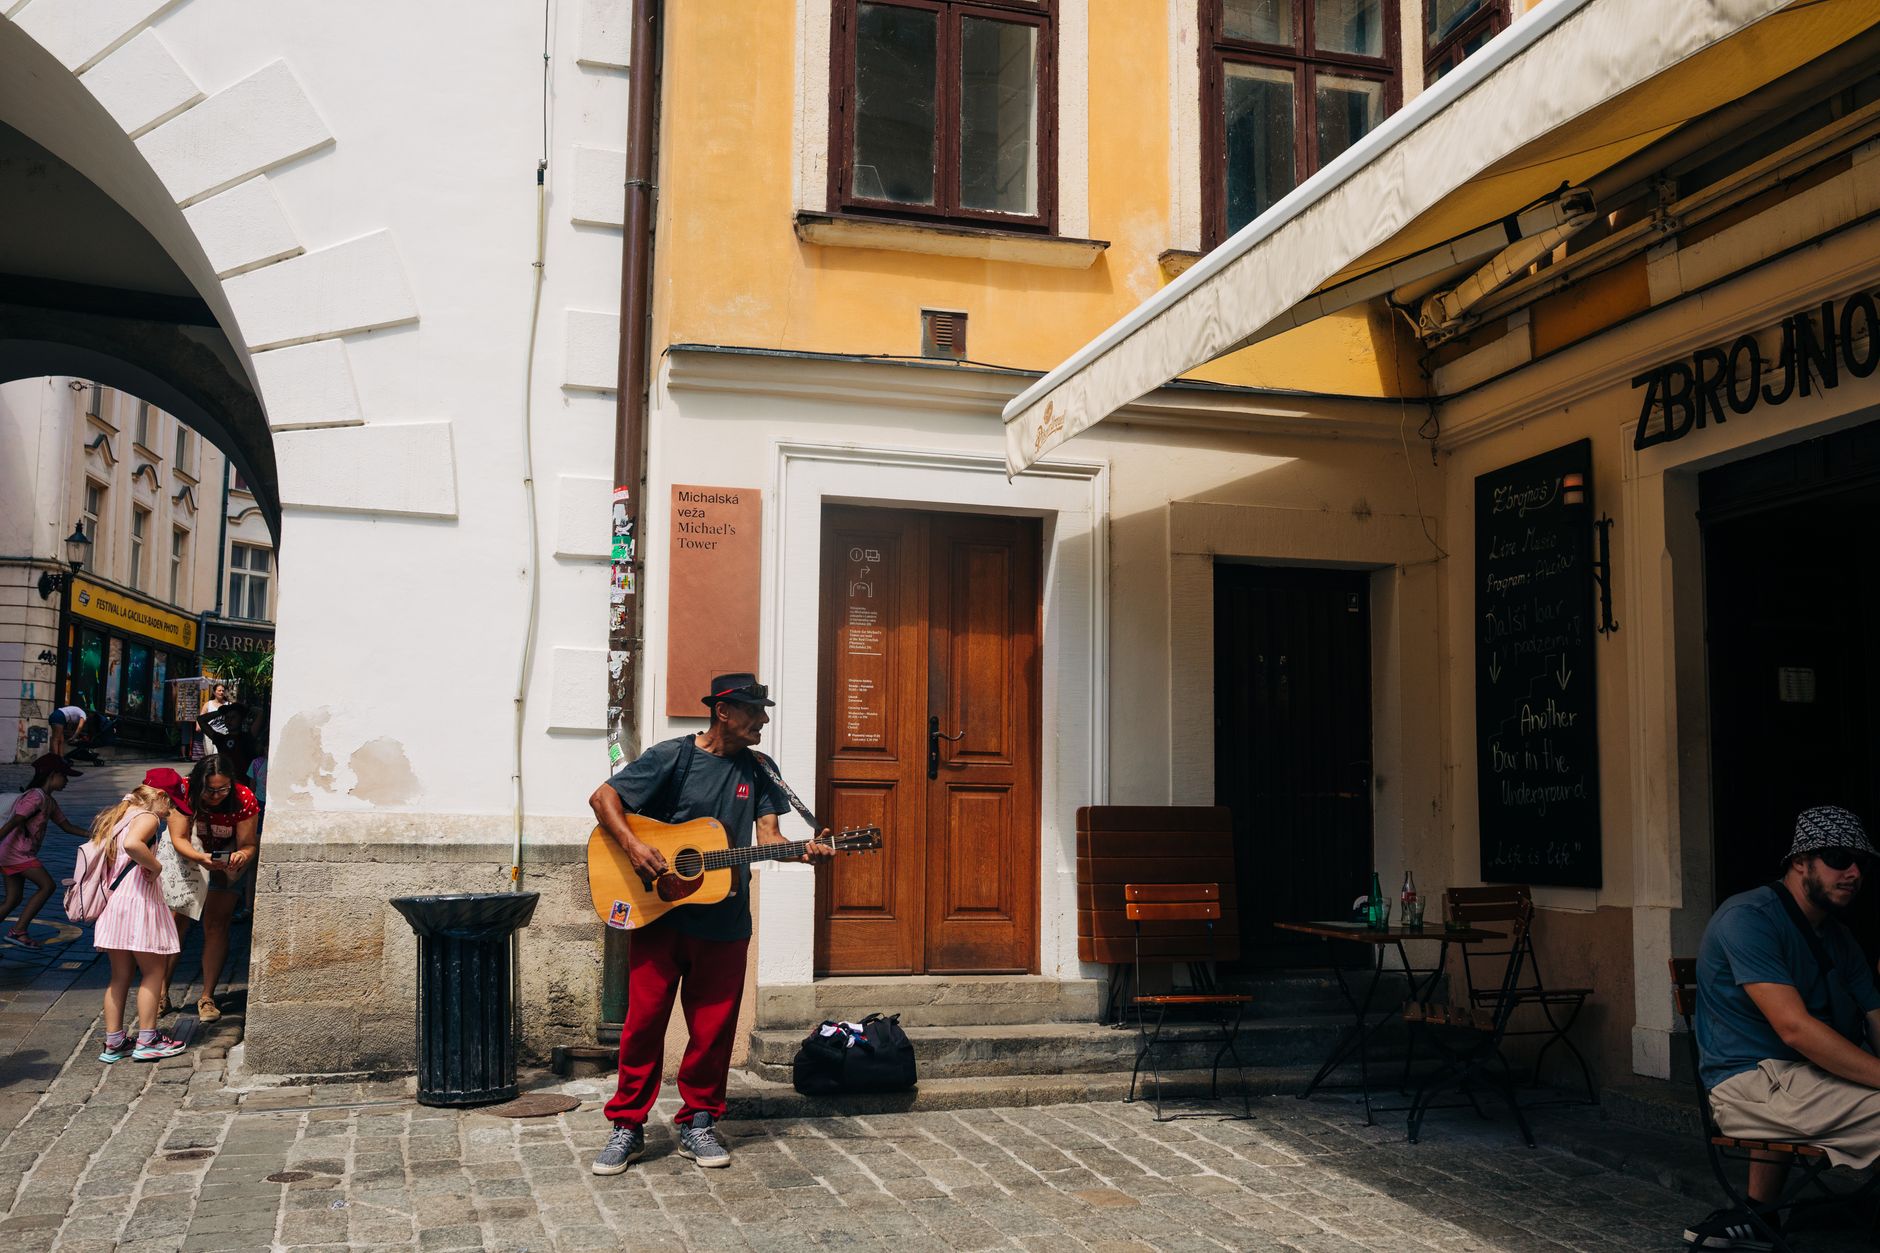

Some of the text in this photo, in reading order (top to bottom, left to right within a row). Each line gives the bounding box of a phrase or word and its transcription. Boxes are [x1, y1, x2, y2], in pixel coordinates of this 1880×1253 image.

[1632, 293, 1880, 451] ZBROJNO
[678, 491, 740, 505] Michalská
[677, 508, 706, 519] veža
[678, 522, 737, 536] Michael's
[677, 538, 718, 550] Tower
[96, 598, 119, 615] FESTIVAL
[119, 605, 127, 617] LA
[163, 622, 179, 635] PHOTO
[1521, 698, 1577, 736] Another
[1493, 738, 1570, 775] Bar in the
